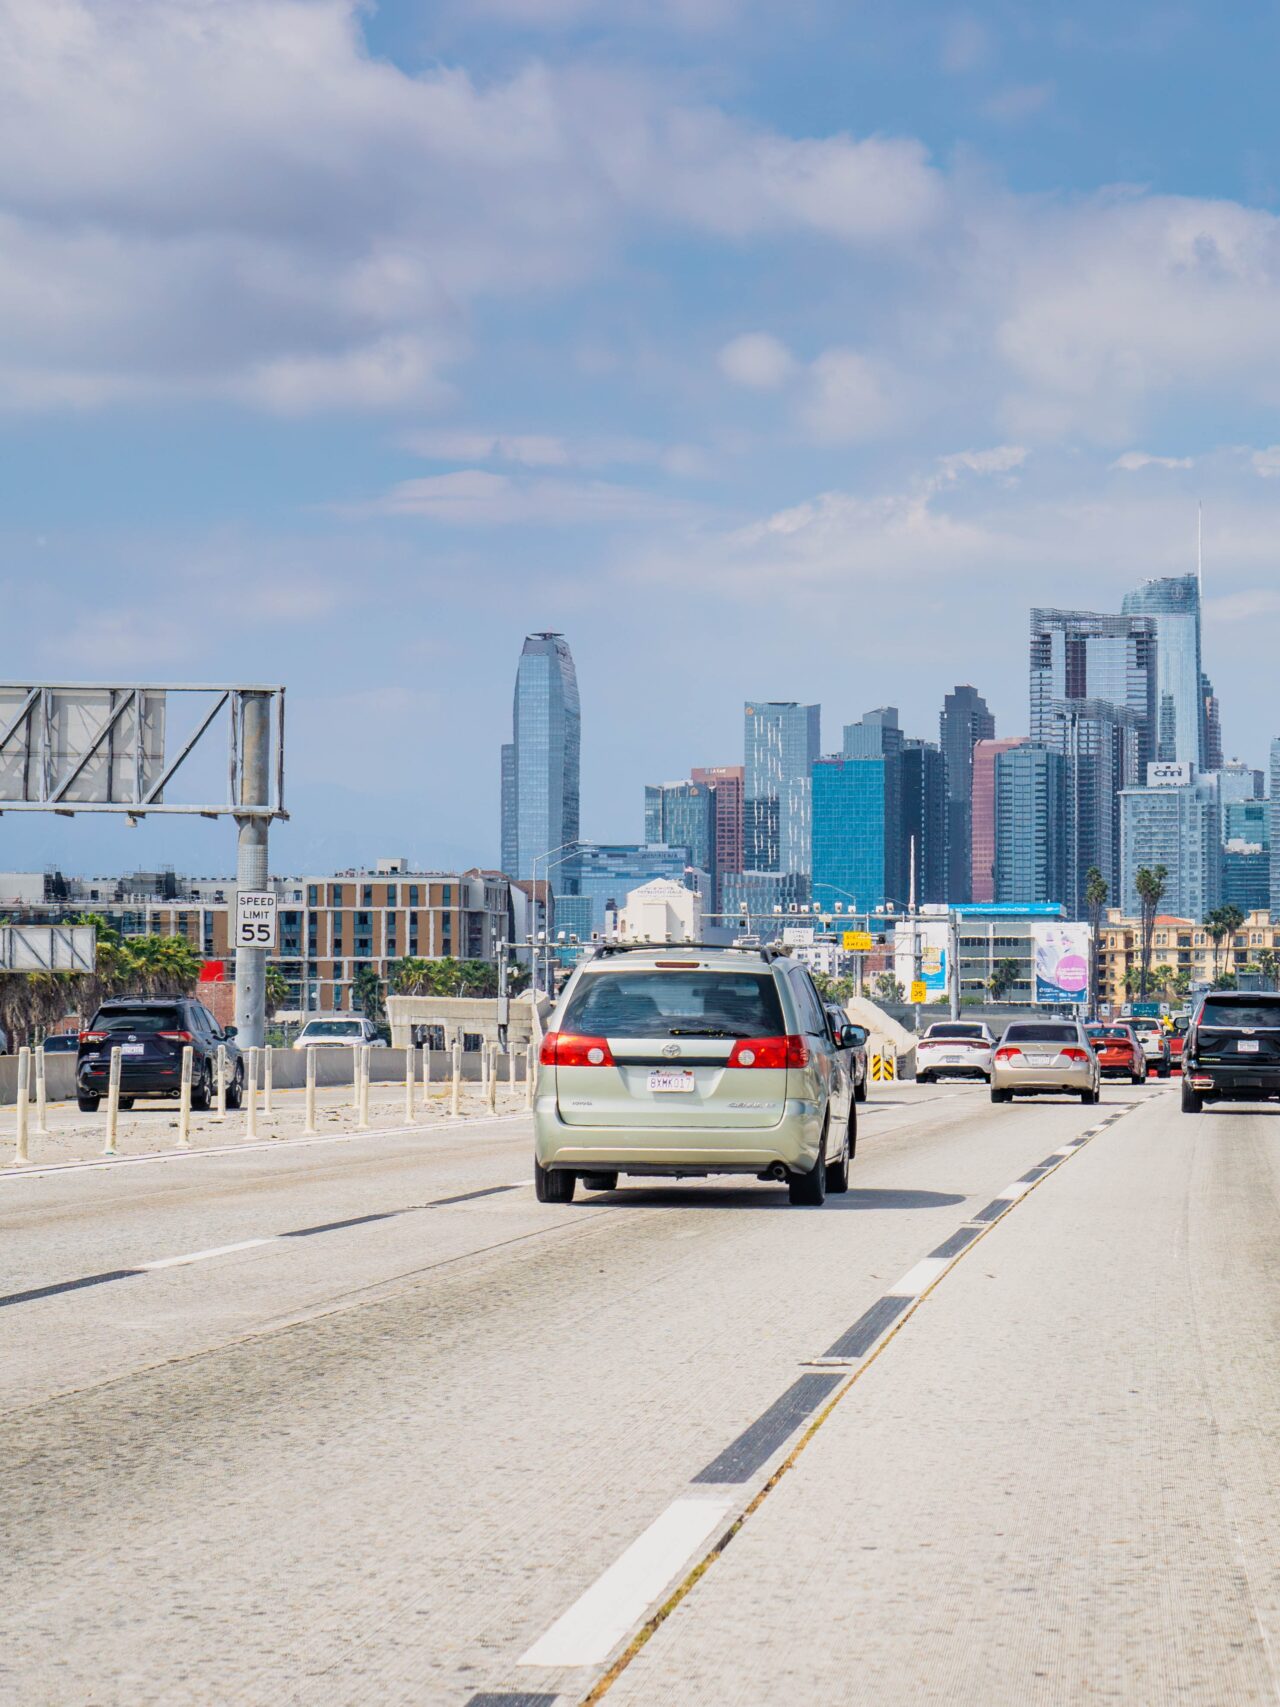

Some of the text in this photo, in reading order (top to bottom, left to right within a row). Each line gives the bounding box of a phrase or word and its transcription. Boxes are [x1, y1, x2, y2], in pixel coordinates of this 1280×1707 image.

[240, 897, 274, 906] SPEED
[243, 910, 270, 919] LIMIT
[242, 924, 271, 942] 55
[650, 1077, 692, 1089] 8XMK017
